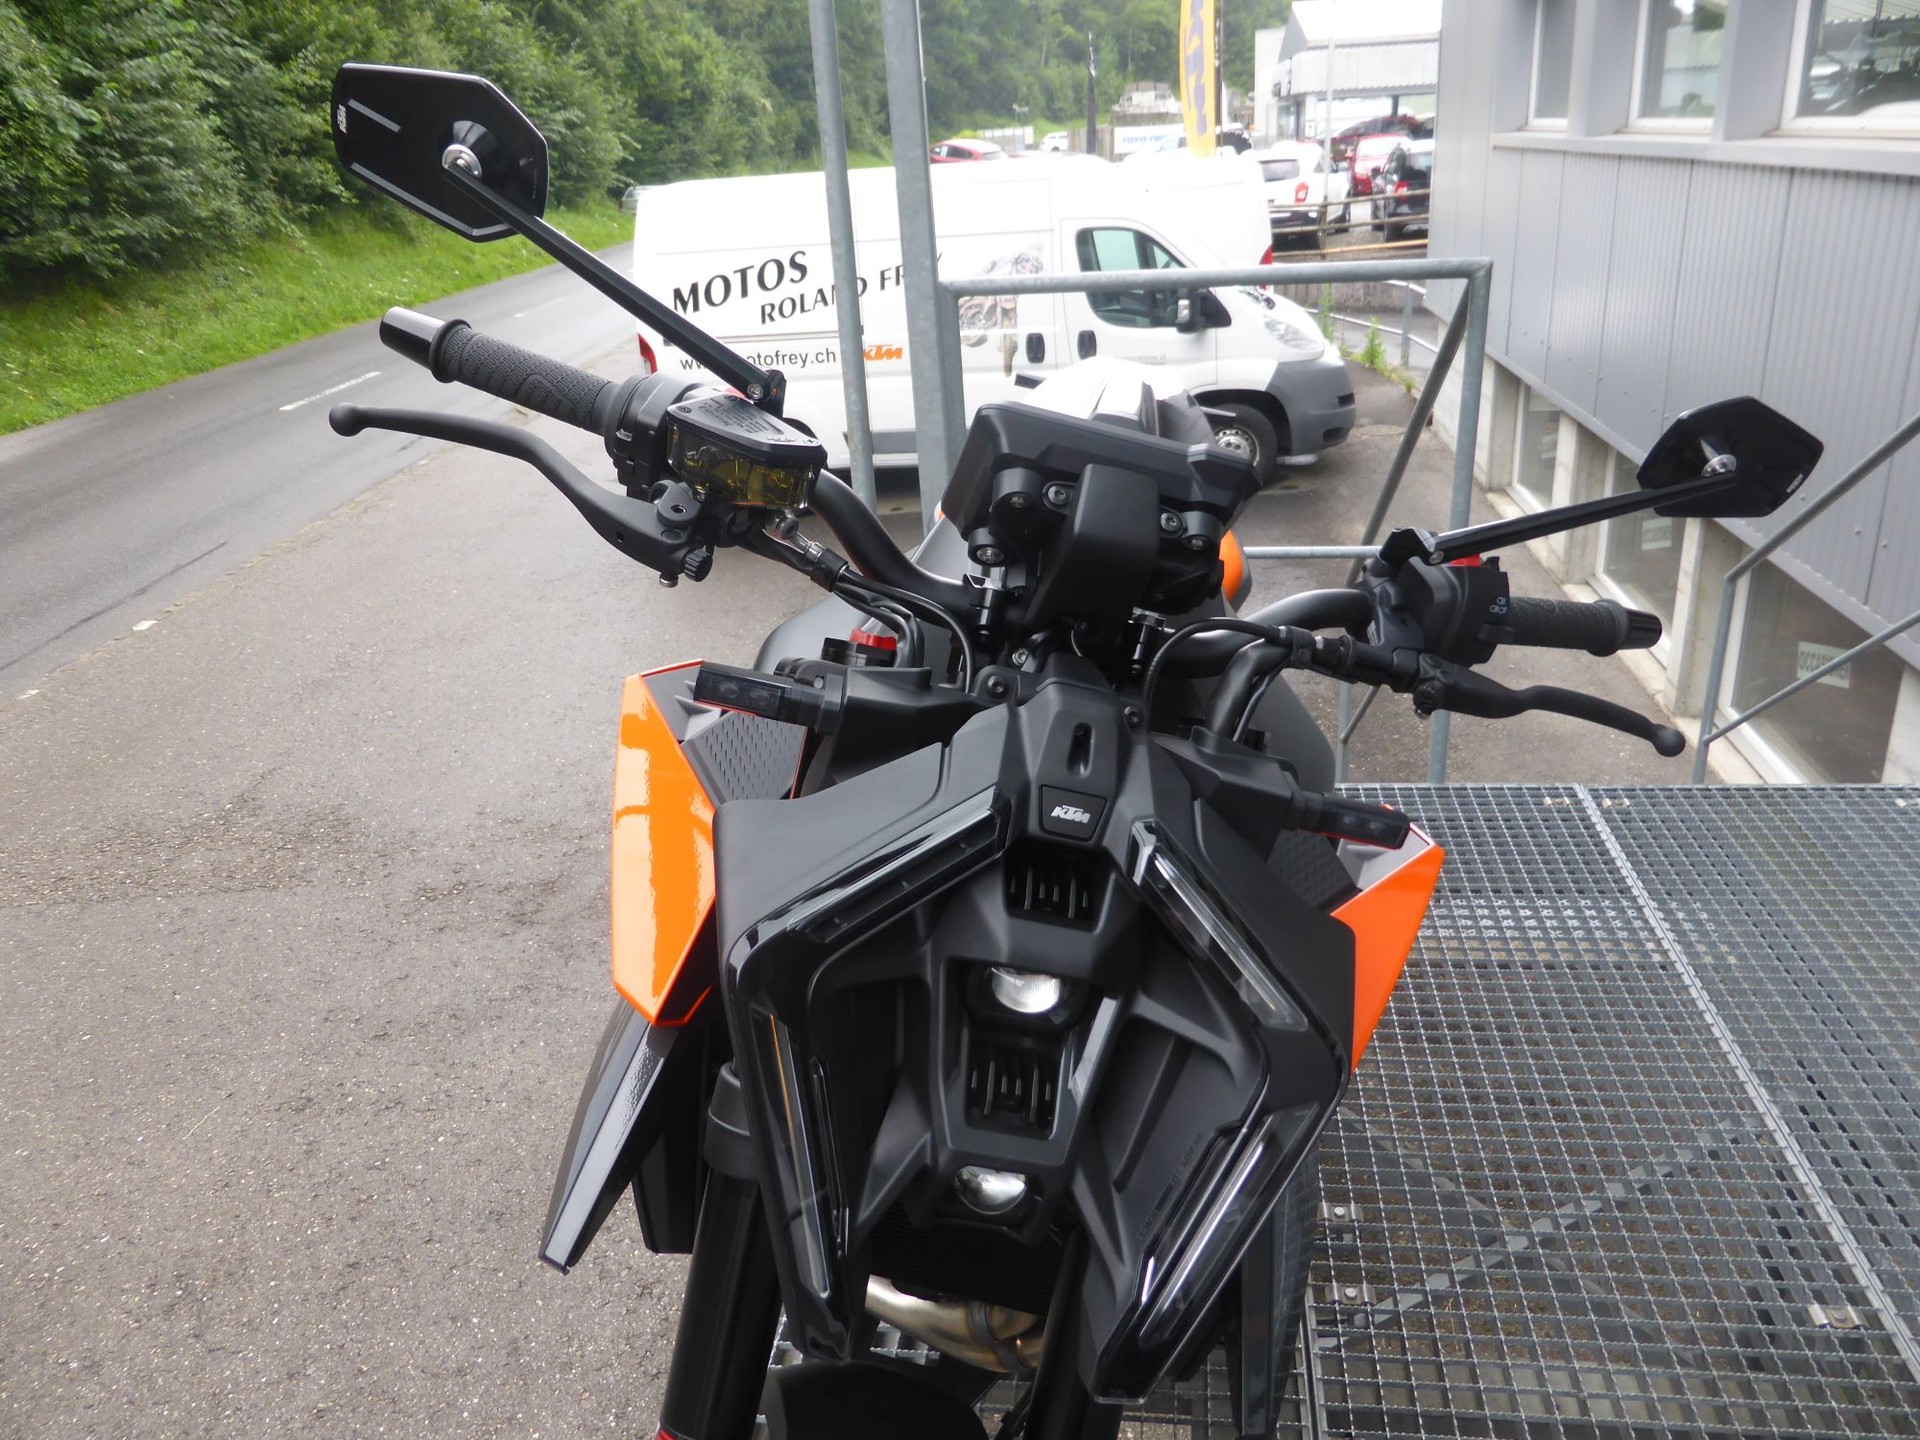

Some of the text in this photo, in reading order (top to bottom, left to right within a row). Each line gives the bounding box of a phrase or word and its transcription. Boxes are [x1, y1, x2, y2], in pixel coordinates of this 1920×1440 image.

[673, 250, 808, 315] MOTOS
[760, 276, 868, 325] ROLAD
[1051, 804, 1091, 824] KTM
